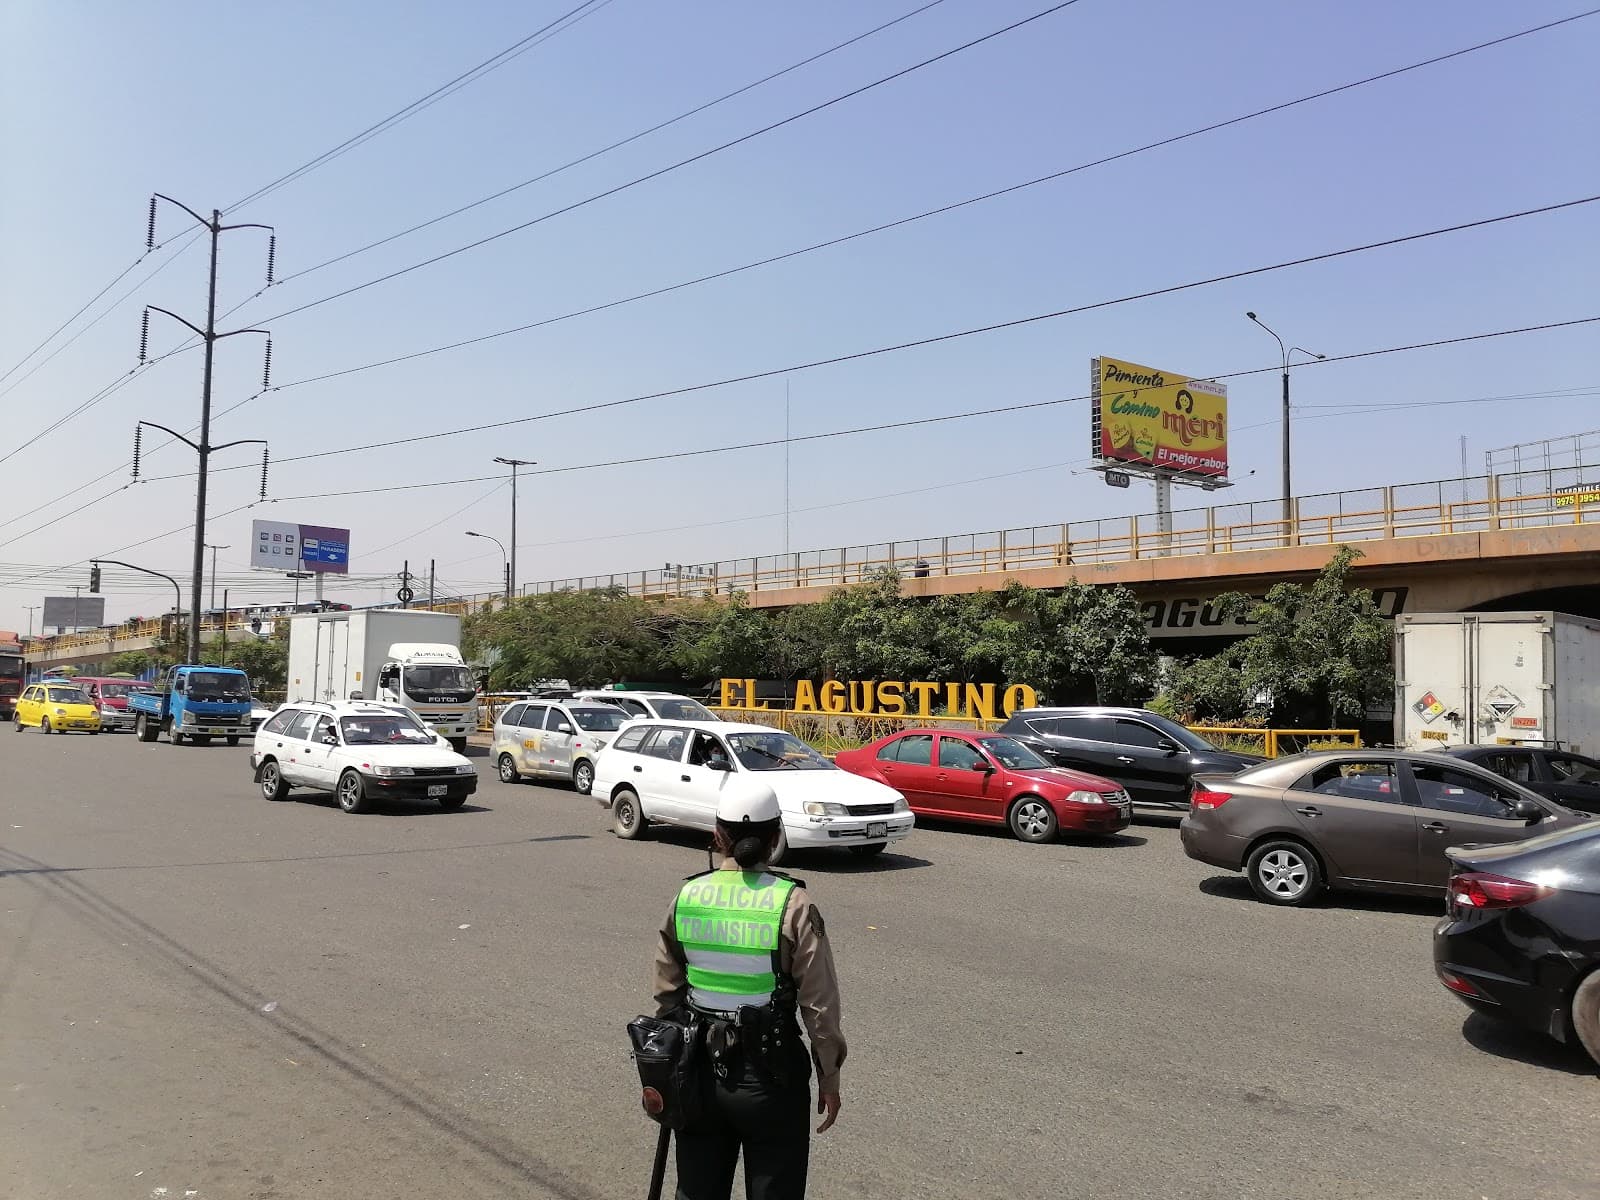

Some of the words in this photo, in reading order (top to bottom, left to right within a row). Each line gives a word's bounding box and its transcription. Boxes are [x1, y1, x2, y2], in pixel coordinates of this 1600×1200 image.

[1104, 364, 1164, 387] Pimienta
[1110, 394, 1161, 419] Comino
[1157, 448, 1167, 460] El
[1169, 452, 1199, 466] mejor
[719, 677, 769, 710] EL
[793, 678, 1038, 720] AGUSTINO
[686, 884, 775, 910] POLICIA
[680, 917, 774, 947] TRANSITO
